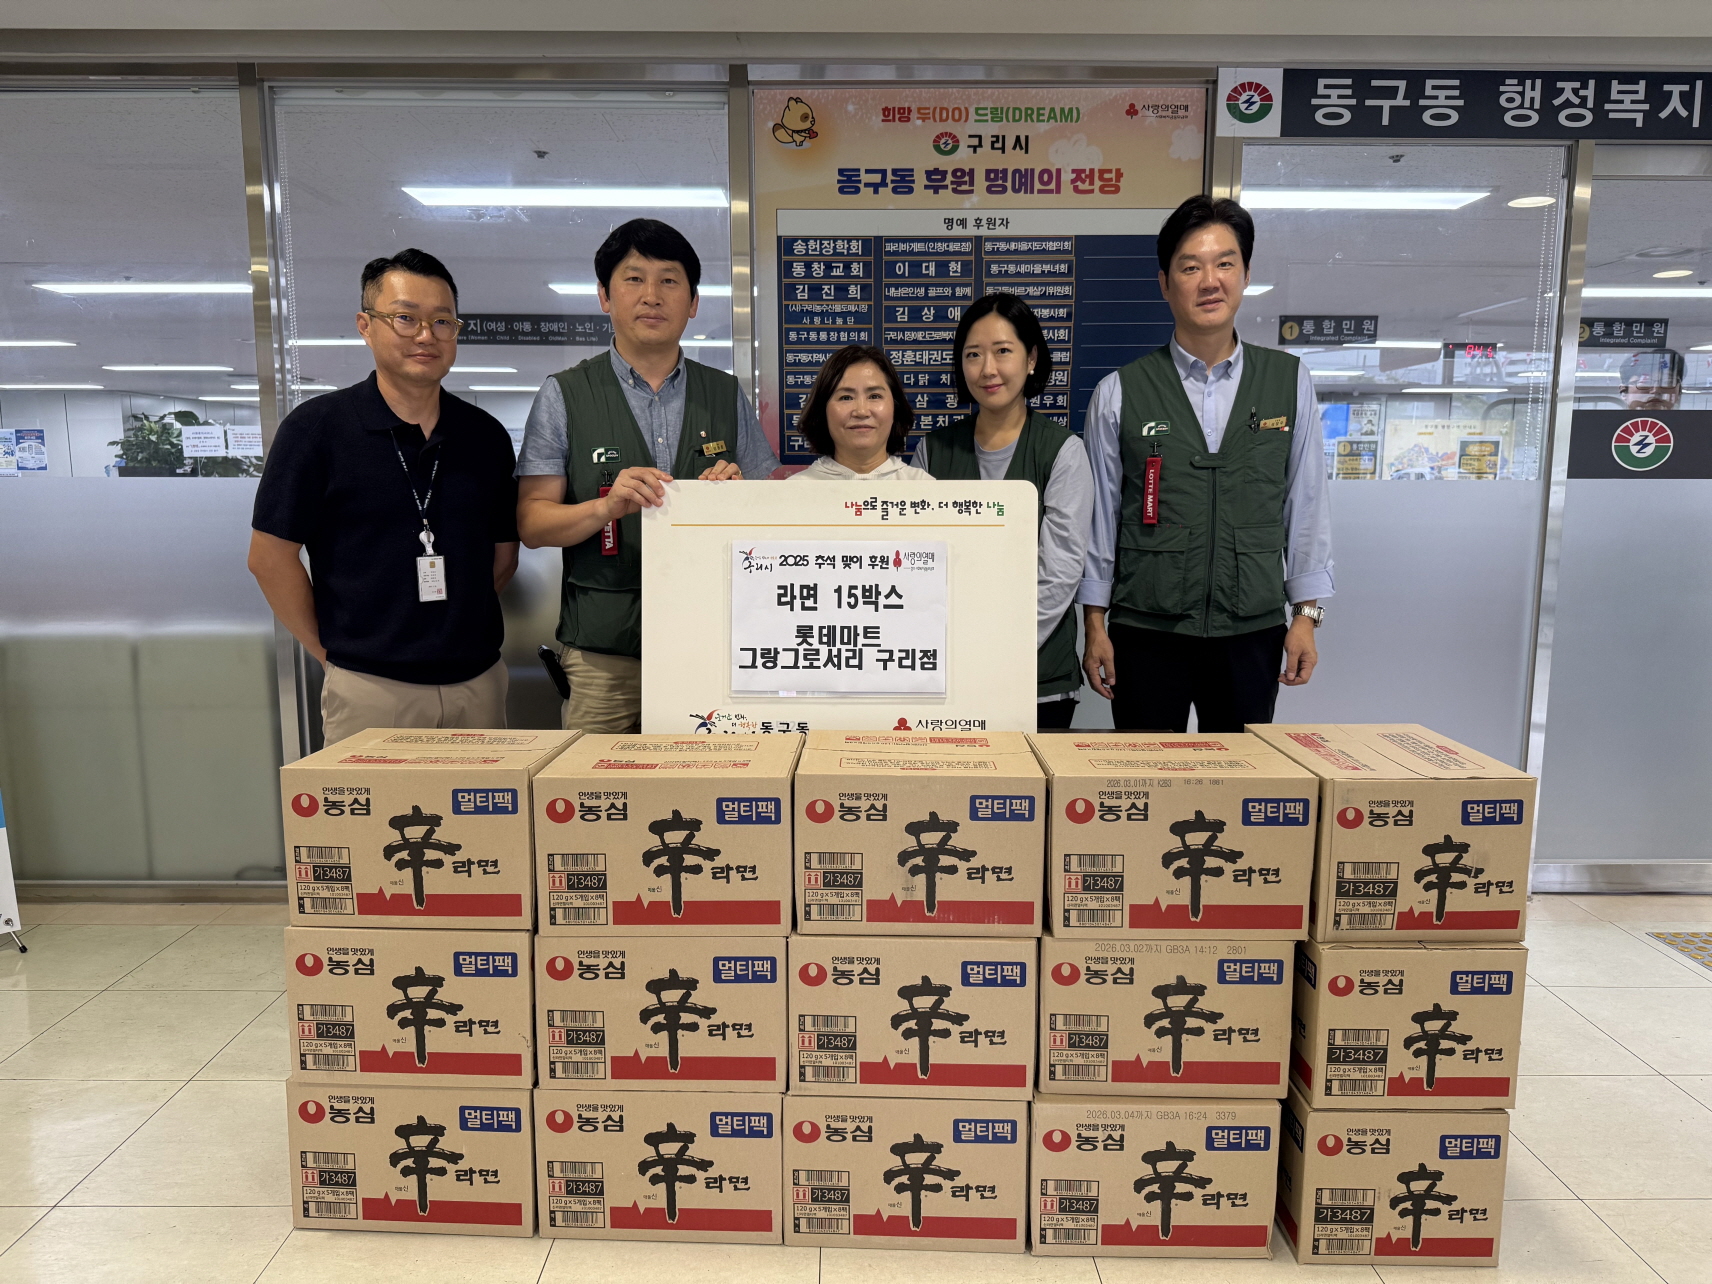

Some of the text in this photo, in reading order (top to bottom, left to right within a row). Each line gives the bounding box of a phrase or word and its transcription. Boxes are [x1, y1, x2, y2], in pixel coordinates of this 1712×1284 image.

[1310, 78, 1703, 128] 동구동 행정복지
[881, 106, 1081, 124] 희망 두(DO) 드림(DREAM)
[966, 134, 1030, 154] 구리시
[836, 167, 1124, 195] 동구동 후원 명예의 전당
[943, 216, 1010, 230] 명예 후원자
[792, 240, 862, 255] 송헌장학회
[990, 264, 1067, 274] 동구동새마을부녀회
[789, 332, 868, 341] 동구동통장협의회
[844, 497, 877, 516] 나눔으로
[881, 500, 906, 520] 즐거운
[952, 500, 983, 516] 행복한
[987, 502, 1004, 516] 나눔
[779, 555, 889, 569] 2025 추석 맞이 후원
[903, 552, 934, 565] 사랑의열매
[776, 583, 904, 612] 라면 15박스
[795, 624, 882, 648] 롯데마트
[739, 648, 938, 671] 그랑그로서리 구리점
[916, 719, 986, 731] 사랑의열매
[323, 797, 370, 817] 농심
[458, 792, 512, 811] 멀티팩
[723, 801, 774, 820] 멀티팩
[976, 799, 1028, 817] 멀티팩
[578, 802, 628, 822] 농심
[837, 802, 887, 823] 농심
[1097, 801, 1149, 823] 농심
[1249, 803, 1303, 822] 멀티팩
[1368, 809, 1413, 827] 농심
[1468, 803, 1517, 821] 멀티팩
[384, 805, 462, 909] 辛
[642, 809, 722, 916] 辛
[898, 811, 977, 915] 辛
[1161, 810, 1245, 920] 辛
[451, 858, 499, 879] 라면
[710, 863, 758, 884] 라면
[965, 864, 1013, 885] 라면
[1231, 865, 1283, 888] 라면
[568, 876, 605, 888] 가3487
[824, 873, 861, 886] 가3487
[1084, 877, 1122, 890] 가3487
[1414, 834, 1485, 923] 辛
[1473, 880, 1514, 896] 라면
[1340, 882, 1394, 895] 가3487
[1095, 943, 1247, 954] 2026.03.02까지 GB3A 14:12 2801
[327, 957, 374, 977] 농심
[460, 956, 511, 974] 멀티팩
[577, 960, 625, 980] 농심
[719, 961, 770, 979] 멀티팩
[967, 965, 1020, 983] 멀티팩
[1224, 963, 1277, 981] 멀티팩
[831, 966, 880, 986] 농심
[1084, 966, 1134, 986] 농심
[1457, 974, 1507, 991] 멀티팩
[1358, 978, 1403, 996] 농심
[388, 966, 464, 1066] 辛
[639, 968, 718, 1072] 辛
[1144, 974, 1224, 1075] 辛
[453, 1017, 500, 1038] 라면
[707, 1021, 754, 1041] 라면
[891, 975, 970, 1078] 辛
[1211, 1026, 1261, 1046] 라면
[568, 1031, 603, 1044] 가3487
[818, 1036, 854, 1049] 가3487
[958, 1028, 1007, 1049] 라면
[1069, 1035, 1106, 1048] 가3487
[1403, 1003, 1474, 1089] 辛
[1331, 1049, 1384, 1062] 가3487
[1462, 1047, 1503, 1064] 라면
[329, 1105, 375, 1125] 농심
[465, 1110, 515, 1129] 멀티팩
[577, 1113, 624, 1133] 농심
[1086, 1110, 1236, 1120] 2026.03.04까지 GB3A 16:24 3379
[716, 1116, 767, 1134] 멀티팩
[824, 1124, 872, 1143] 농심
[959, 1122, 1011, 1140] 멀티팩
[1075, 1133, 1124, 1152] 농심
[1212, 1130, 1264, 1147] 멀티팩
[1346, 1137, 1390, 1155] 농심
[1446, 1138, 1495, 1155] 멀티팩
[389, 1115, 465, 1214] 辛
[638, 1122, 715, 1222] 辛
[320, 1172, 354, 1186] 가3487
[454, 1166, 500, 1188] 라면
[704, 1173, 751, 1194] 라면
[884, 1133, 961, 1229] 辛
[567, 1182, 602, 1195] 가3487
[812, 1189, 848, 1202] 가3487
[949, 1183, 996, 1203] 라면
[1134, 1141, 1213, 1239] 辛
[1060, 1200, 1096, 1212] 가3487
[1200, 1191, 1249, 1211] 라면
[1389, 1162, 1459, 1249] 辛
[1319, 1208, 1371, 1221] 가3487
[1447, 1207, 1488, 1224] 라면
